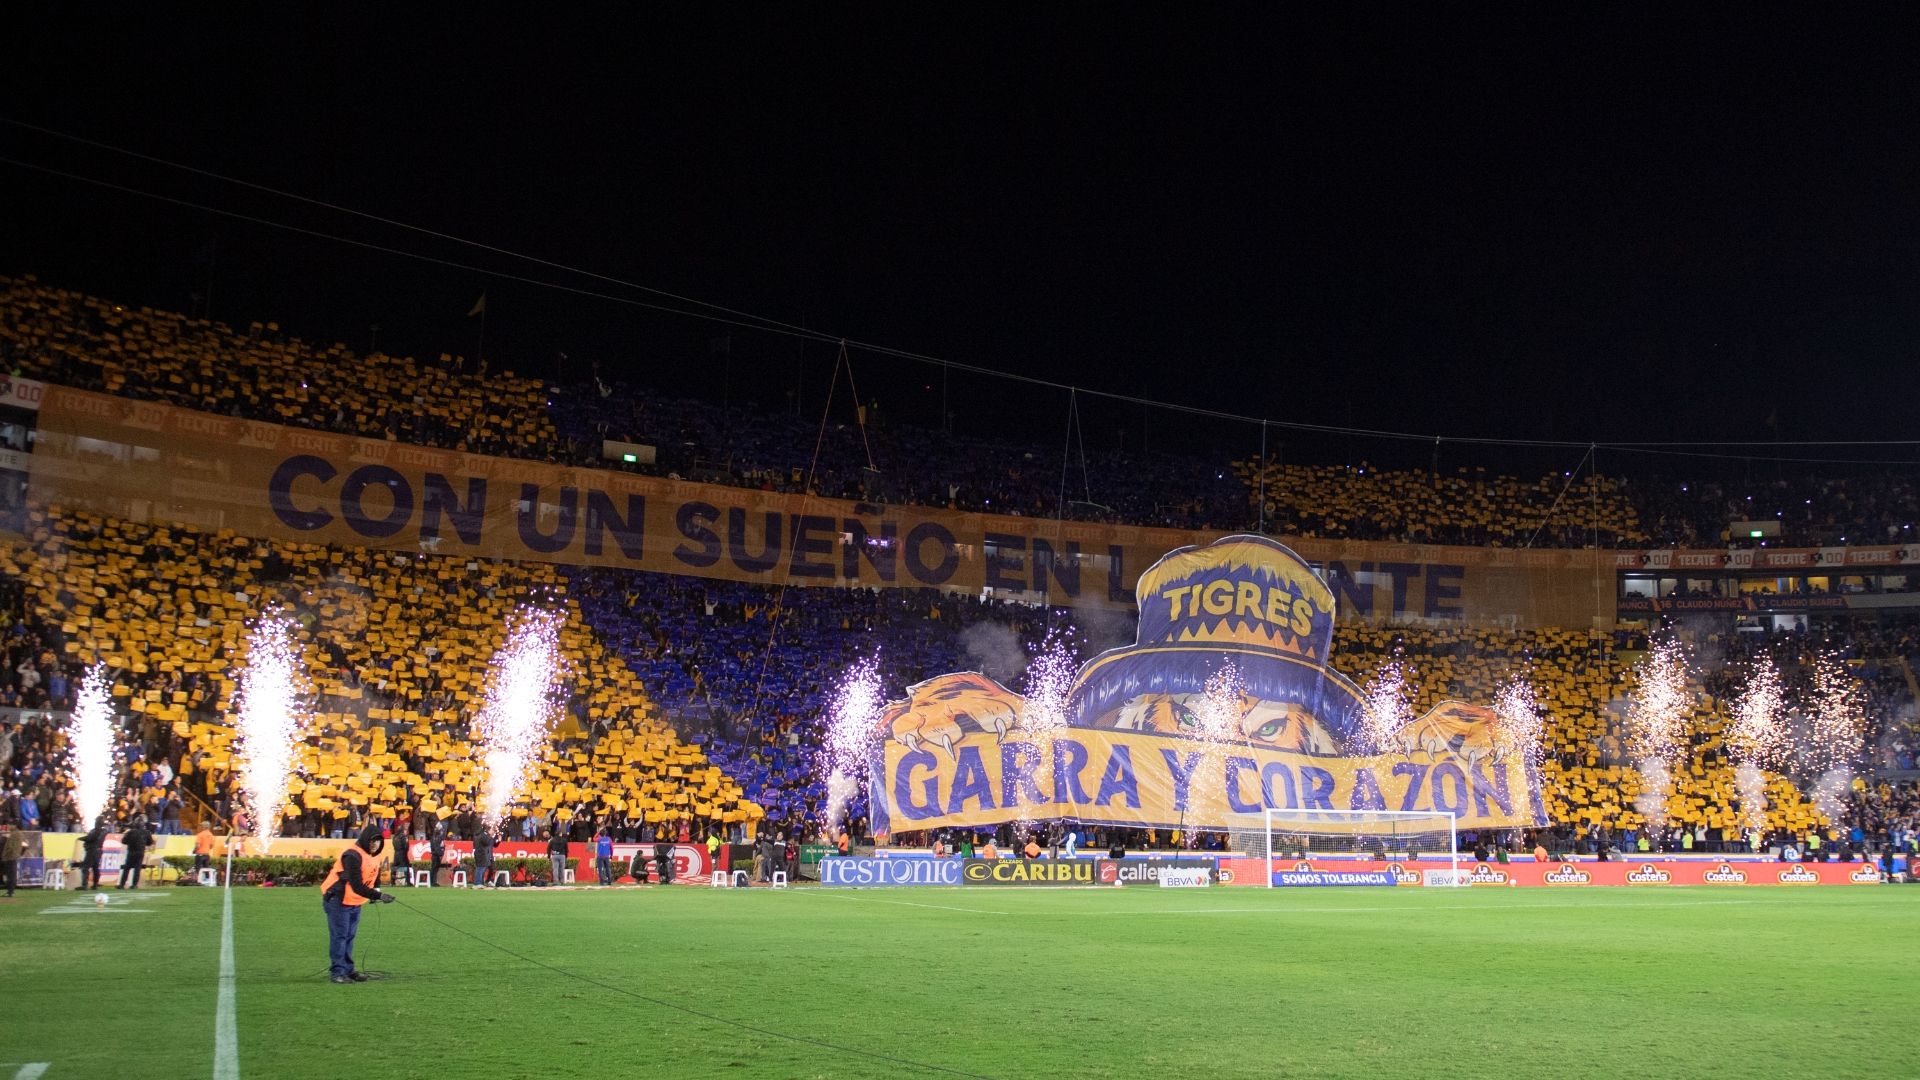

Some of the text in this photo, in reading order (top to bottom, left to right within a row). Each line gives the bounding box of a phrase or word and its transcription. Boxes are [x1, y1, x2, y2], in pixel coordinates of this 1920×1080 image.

[176, 414, 227, 435] TECATE
[288, 432, 339, 452] TECATE
[269, 454, 487, 545] CON
[517, 483, 645, 560] UN
[673, 501, 959, 584] SUEÑO
[984, 533, 1080, 598] EN
[1304, 560, 1464, 620] NTE
[1679, 554, 1717, 566] TECATE
[1766, 553, 1807, 565] TECATE
[1850, 551, 1891, 562] TECATE
[1162, 579, 1314, 637] TIGRES
[1676, 600, 1712, 609] CLAUDIO
[894, 738, 1141, 820] GARRA
[1160, 748, 1202, 811] Y
[993, 863, 1092, 881] CARIBU
[1298, 862, 1309, 872] La
[1478, 865, 1488, 874] La
[1562, 865, 1572, 874] La
[1643, 865, 1652, 873] La
[1720, 865, 1729, 873] La
[1793, 865, 1803, 873] La
[1863, 865, 1873, 873] La
[1167, 878, 1193, 886] BBVA
[1282, 873, 1387, 884] SOMOS TOLERANCIA
[1470, 873, 1504, 882] osteña
[1547, 872, 1587, 882] Costeña
[1629, 872, 1668, 882] Costeña
[1706, 872, 1744, 882] Costeña
[1780, 872, 1816, 882] Costeña
